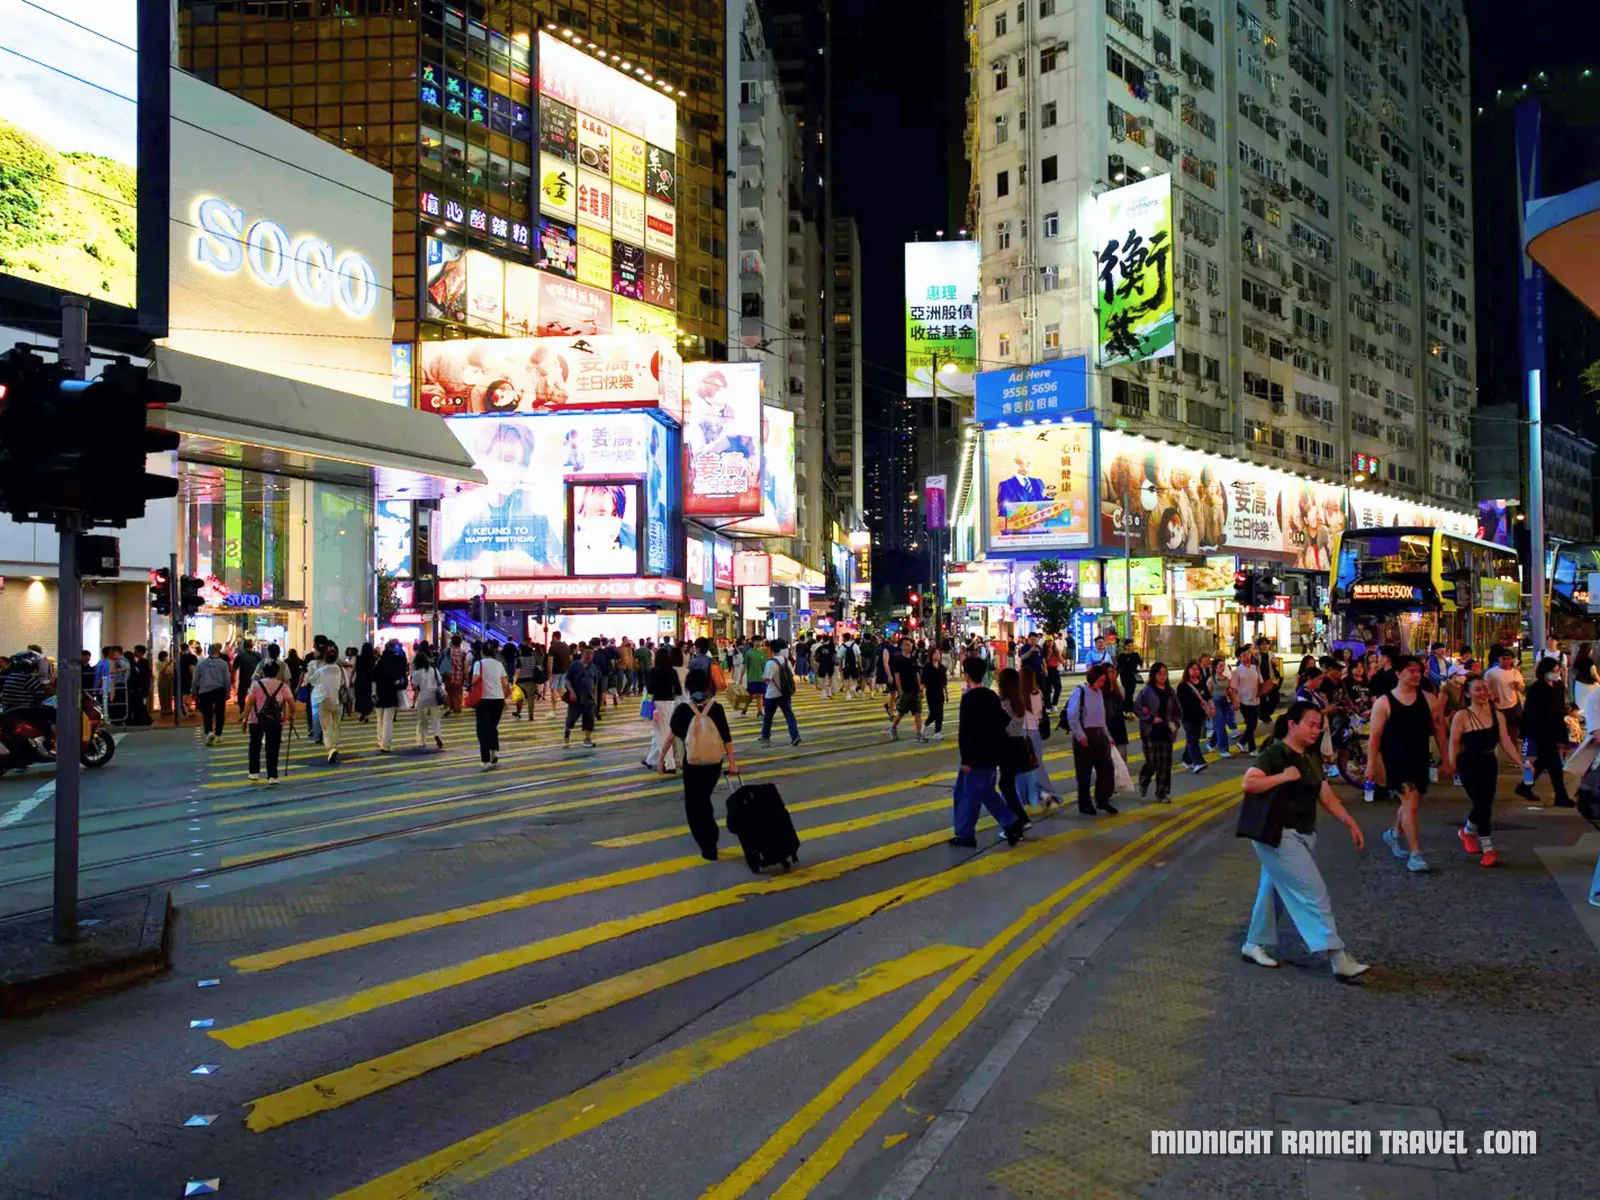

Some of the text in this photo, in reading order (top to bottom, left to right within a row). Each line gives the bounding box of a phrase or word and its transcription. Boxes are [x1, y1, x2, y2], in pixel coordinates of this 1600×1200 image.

[553, 171, 574, 201] 金
[578, 184, 610, 220] 金羅寶
[420, 191, 528, 244] 傷心酸辣粉
[198, 197, 379, 316] SOGO
[1099, 228, 1171, 311] 衡
[926, 285, 957, 301] 惠理
[910, 304, 973, 321] 亞洲股債
[910, 324, 973, 341] 收益基金
[576, 374, 634, 391] 生日快樂
[1008, 369, 1051, 383] Ad Here
[1002, 381, 1058, 399] 9556 5696
[1002, 396, 1058, 414] 廣告位招租
[591, 426, 634, 448] 姜濤
[1235, 480, 1266, 516] 姜濤
[473, 526, 528, 536] KEUNG TO
[1233, 516, 1270, 541] 生日快樂
[465, 535, 537, 544] HAPPY BIRTHDAY
[861, 548, 869, 579] IKEA
[489, 584, 532, 596] HAPPY
[534, 583, 596, 595] BIRTHDAY
[599, 583, 630, 594] 0430
[1389, 585, 1414, 599] 930X
[227, 594, 260, 606] SOGO
